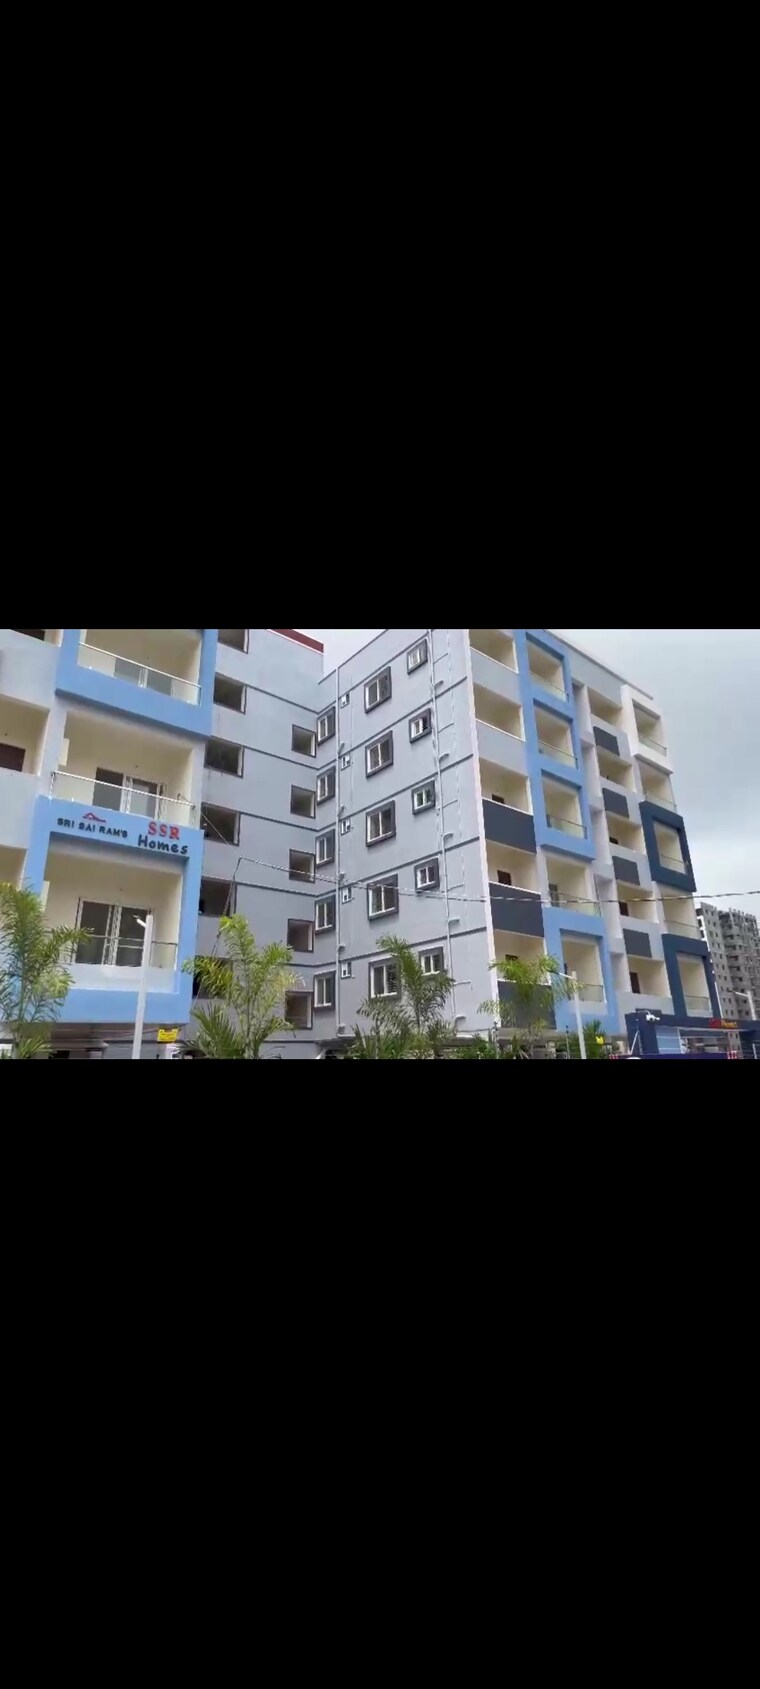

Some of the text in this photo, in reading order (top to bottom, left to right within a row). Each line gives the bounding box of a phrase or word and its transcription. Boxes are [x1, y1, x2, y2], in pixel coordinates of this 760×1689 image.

[57, 817, 128, 839] SRI SAI RAM'S
[148, 820, 180, 840] SSR
[137, 834, 189, 855] Homes
